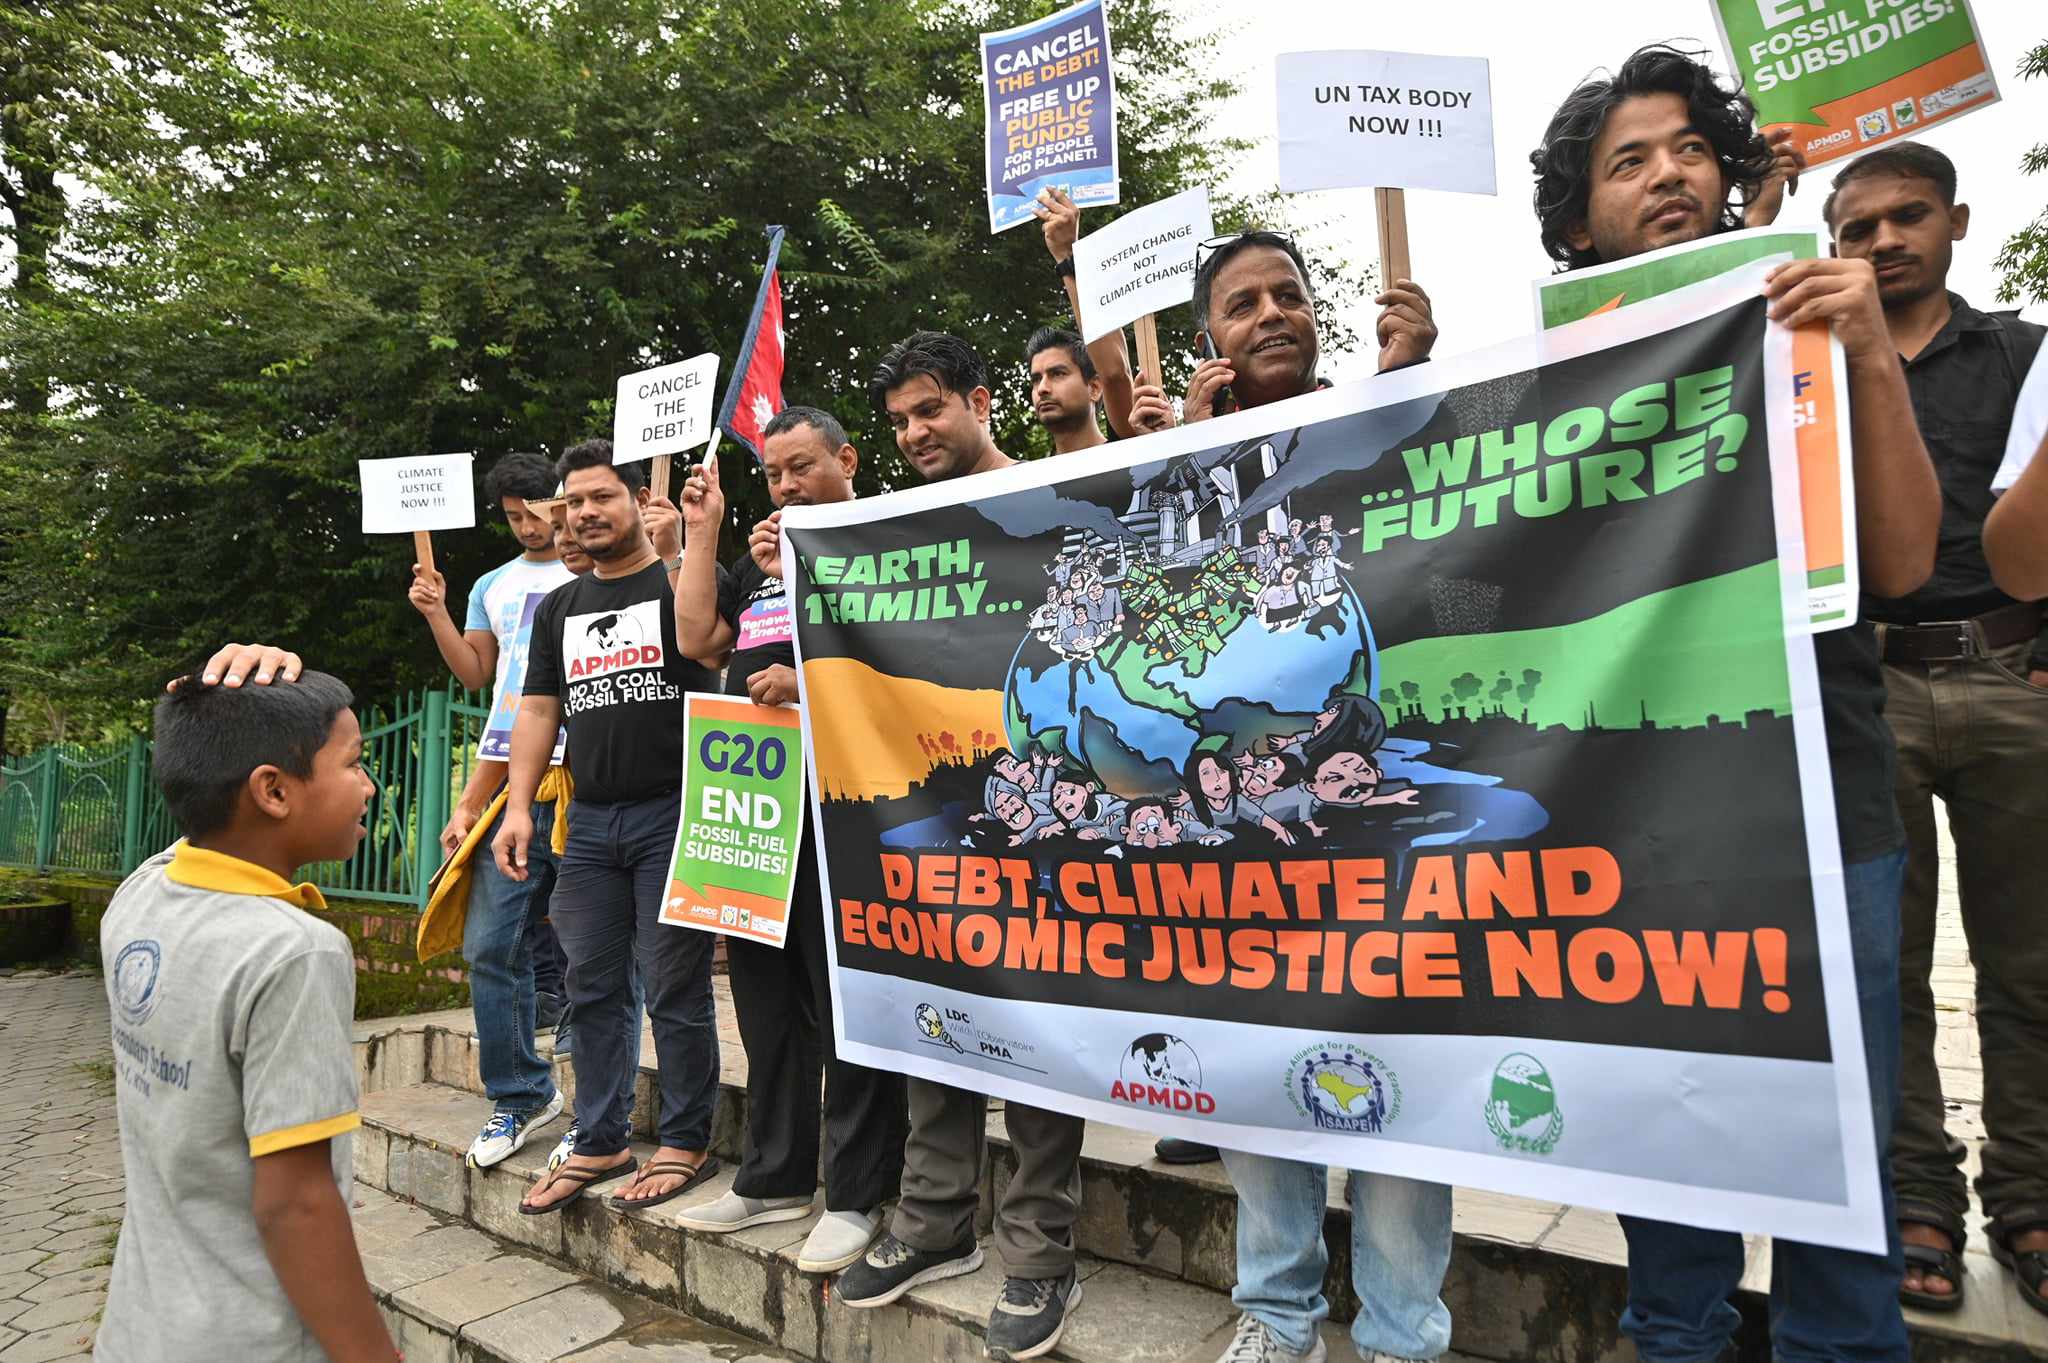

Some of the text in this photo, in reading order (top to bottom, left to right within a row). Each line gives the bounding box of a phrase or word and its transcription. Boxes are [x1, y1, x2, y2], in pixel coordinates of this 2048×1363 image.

[994, 25, 1099, 75] CANCEL
[1749, 10, 1859, 65] FOSSIL
[1754, 0, 1955, 92] SUBSIDIES!
[996, 47, 1100, 94] THE DEBT!
[1000, 76, 1100, 121] FREE UP
[1315, 86, 1472, 108] UN TAX BODY
[1006, 99, 1094, 136] PUBLIC
[1349, 116, 1442, 138] NOW !!!
[1005, 135, 1094, 168] FOR PEOPLE
[1008, 118, 1089, 153] FUNDS
[1806, 129, 1853, 152] APMDD
[1002, 148, 1098, 183] AND PLANET!
[1101, 224, 1192, 270] SYSTEM CHANGE
[1134, 255, 1157, 272] NOT
[1100, 277, 1142, 306] CLIMATE
[638, 372, 702, 399] CANCEL
[654, 398, 686, 417] THE
[642, 421, 685, 443] DEBT
[1361, 365, 1733, 505] ...WHOSE
[398, 467, 444, 479] CLIMATE
[401, 482, 443, 494] JUSTICE
[1362, 413, 1748, 553] FUTURE?
[401, 498, 429, 509] NOW
[814, 538, 984, 585] EARTH,
[804, 592, 823, 624] 1
[749, 625, 792, 639] Energ
[569, 645, 661, 679] APMDD
[569, 672, 666, 701] NO TO COAL
[571, 691, 618, 715] FOSSIL
[624, 685, 680, 703] FUELS!
[700, 730, 786, 780] G20
[702, 785, 781, 830] END
[690, 823, 788, 854] FOSSIL FUEL
[684, 841, 787, 875] SUBSIDIES!
[880, 846, 1622, 921] DEBT, CLIMATE AND
[839, 899, 1791, 1013] ECONOMIC JUSTICE NOW!
[945, 1008, 970, 1023] LDC
[980, 1042, 1013, 1060] PMA
[1327, 1041, 1343, 1049] for
[1347, 1043, 1388, 1071] Poverty
[1110, 1079, 1216, 1115] APMDD
[1326, 1116, 1369, 1131] SAAPE
